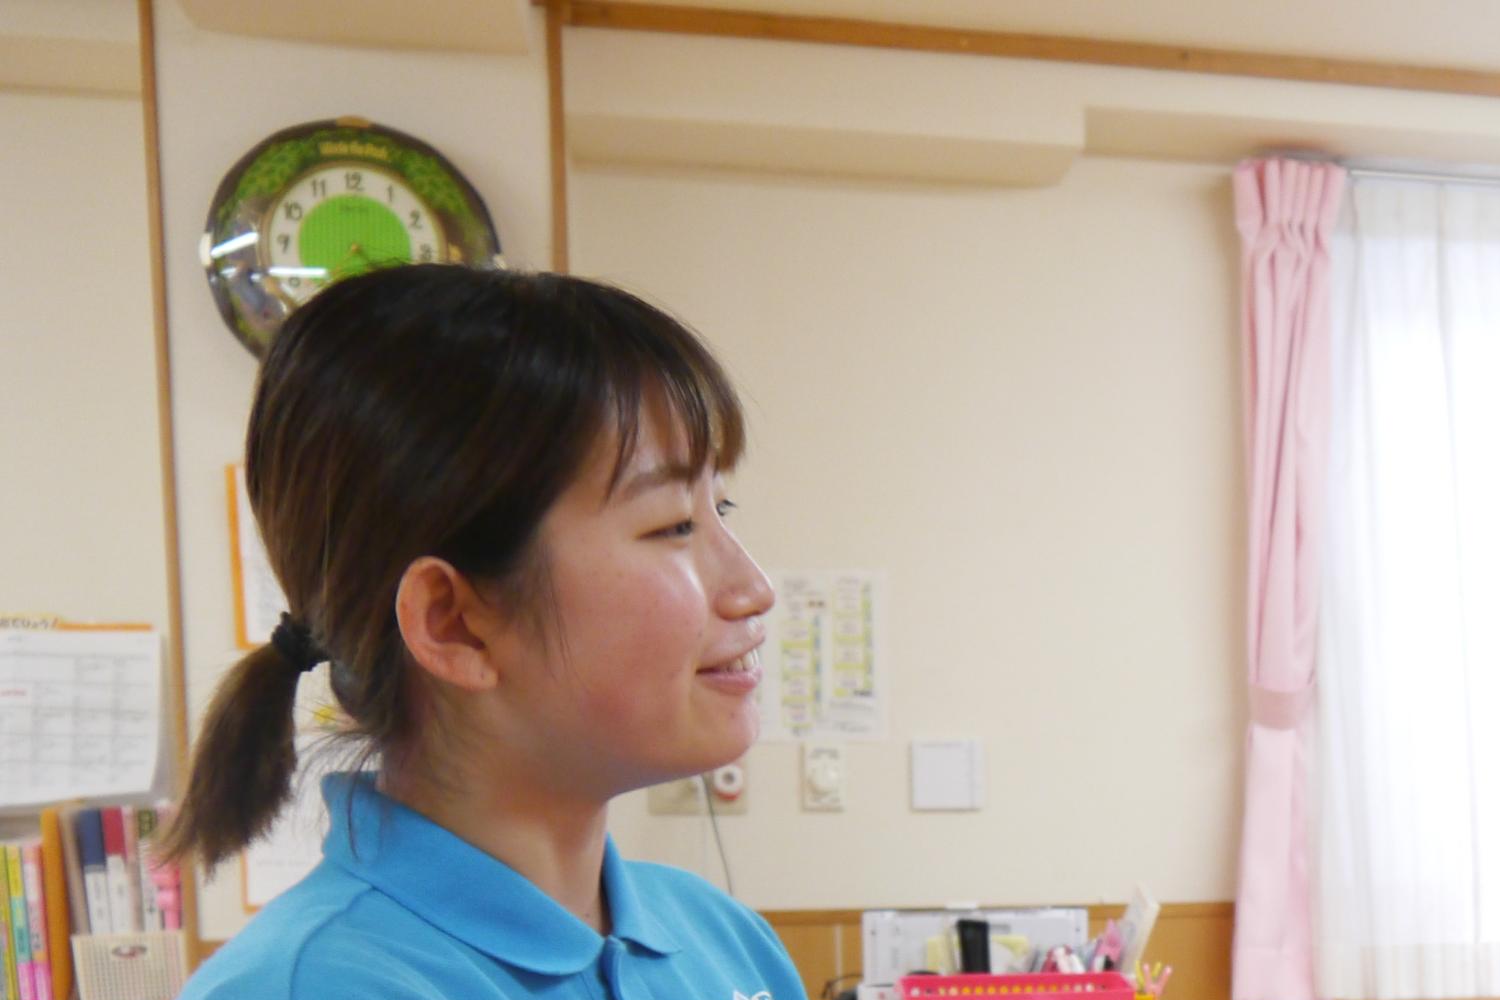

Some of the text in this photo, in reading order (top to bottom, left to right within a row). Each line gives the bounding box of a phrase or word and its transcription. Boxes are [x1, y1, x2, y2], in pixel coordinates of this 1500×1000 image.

[312, 180, 326, 197] 11
[345, 172, 364, 191] 12
[387, 185, 394, 202] 1
[284, 202, 302, 221] 10
[410, 210, 422, 229] 2
[278, 234, 290, 253] 9
